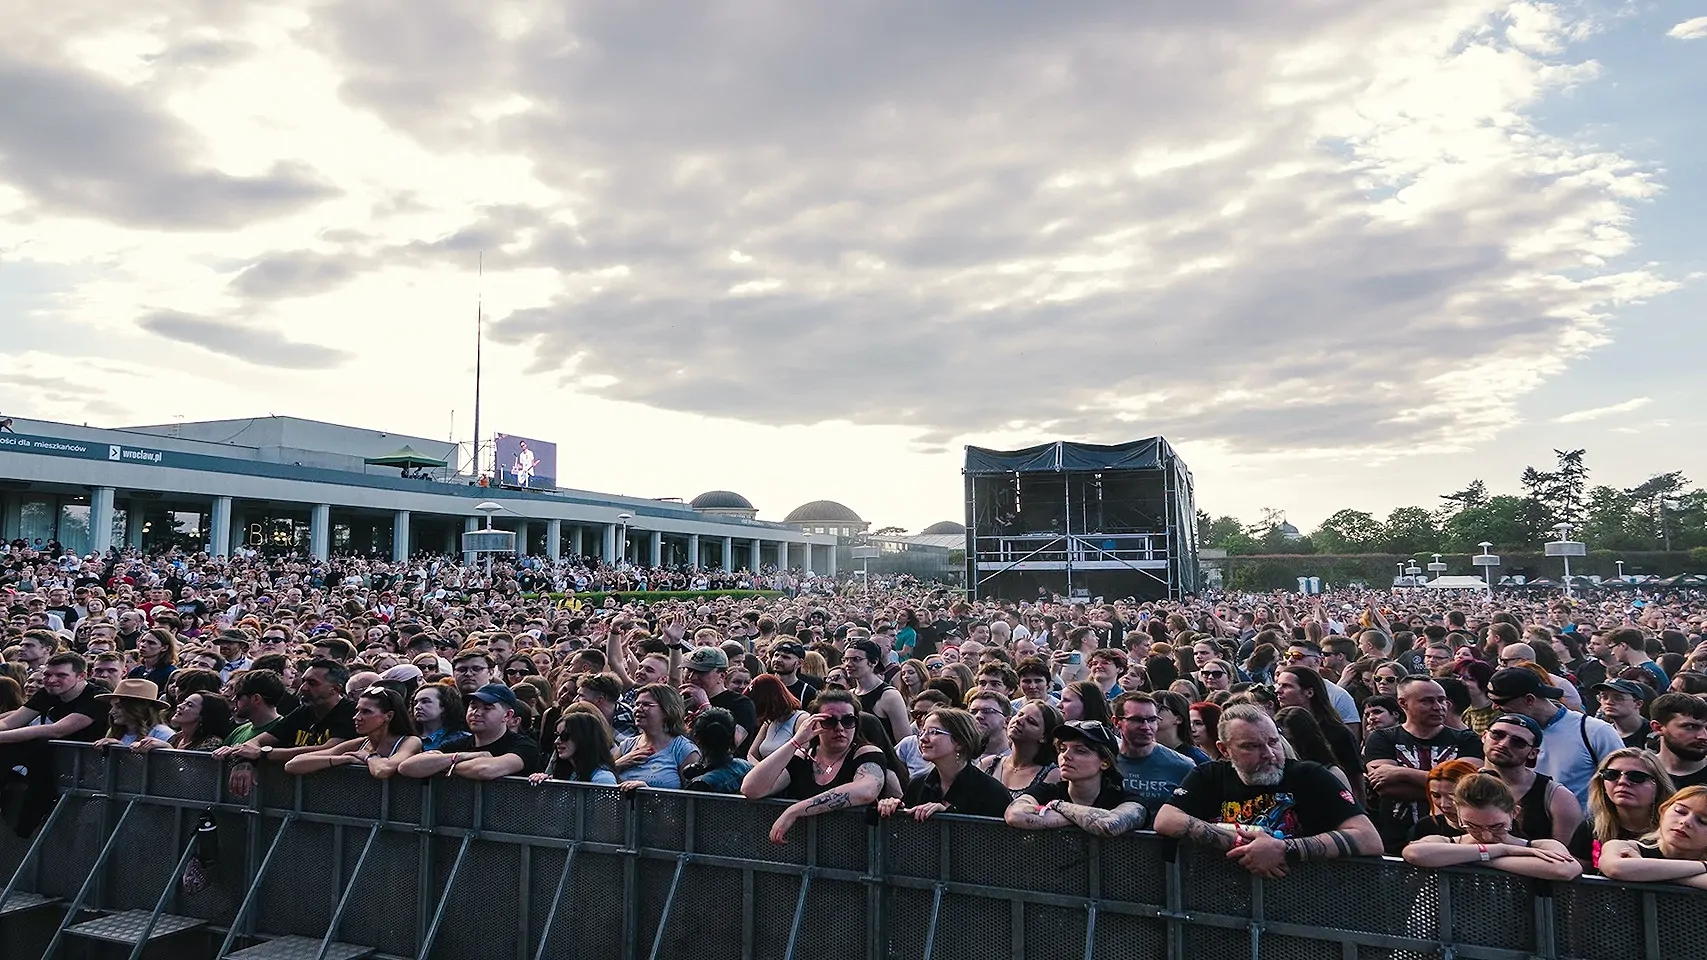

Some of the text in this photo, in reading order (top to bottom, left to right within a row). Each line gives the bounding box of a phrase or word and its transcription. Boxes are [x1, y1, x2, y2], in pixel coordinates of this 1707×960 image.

[18, 439, 31, 447] dla
[34, 441, 87, 453] mieszkańców
[1122, 779, 1171, 793] TCHER
